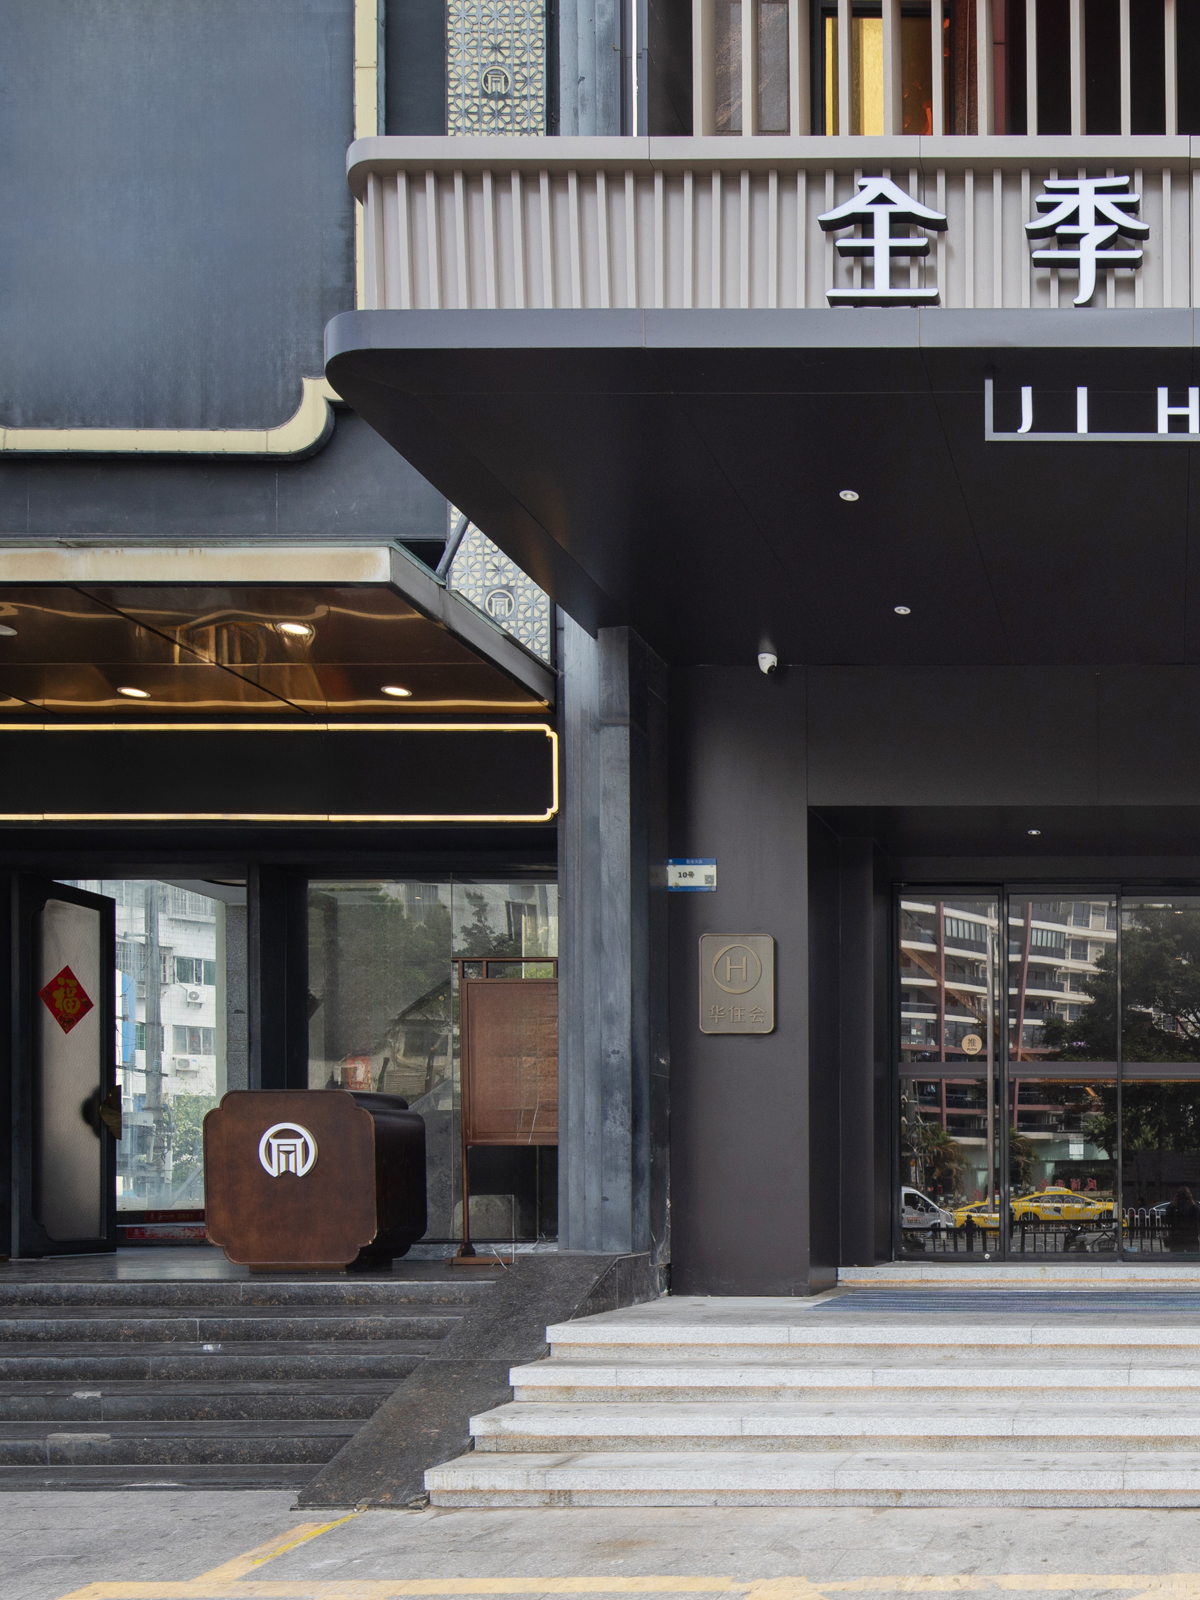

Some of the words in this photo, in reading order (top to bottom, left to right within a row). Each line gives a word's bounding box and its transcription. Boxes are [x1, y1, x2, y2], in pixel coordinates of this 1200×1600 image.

[1016, 386, 1088, 435] JI
[52, 976, 82, 1015] 福
[709, 1004, 766, 1024] 华住会
[967, 1037, 977, 1047] 推
